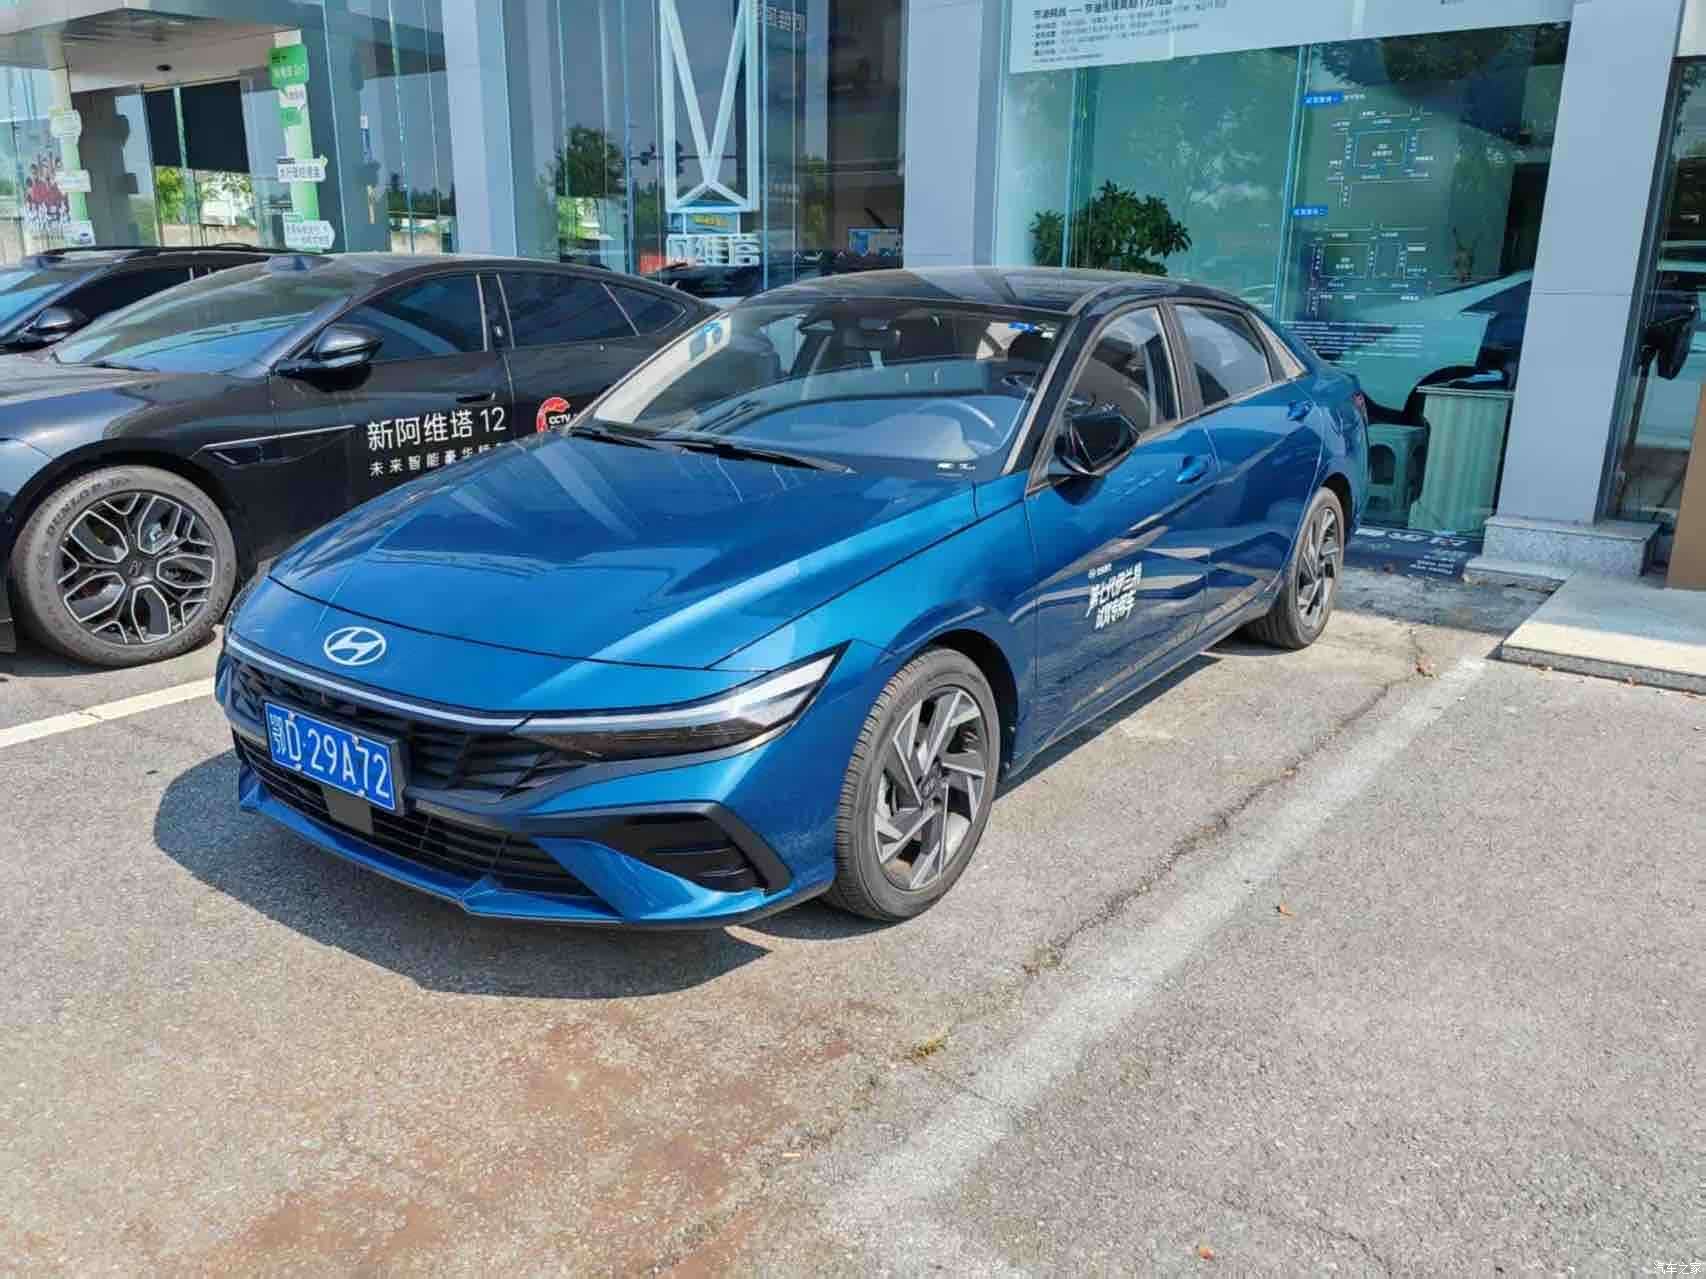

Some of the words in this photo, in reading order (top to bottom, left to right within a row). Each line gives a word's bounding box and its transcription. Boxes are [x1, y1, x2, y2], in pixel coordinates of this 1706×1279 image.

[367, 408, 474, 451] 新阿维塔
[480, 406, 507, 432] 12
[548, 413, 571, 425] CCTV
